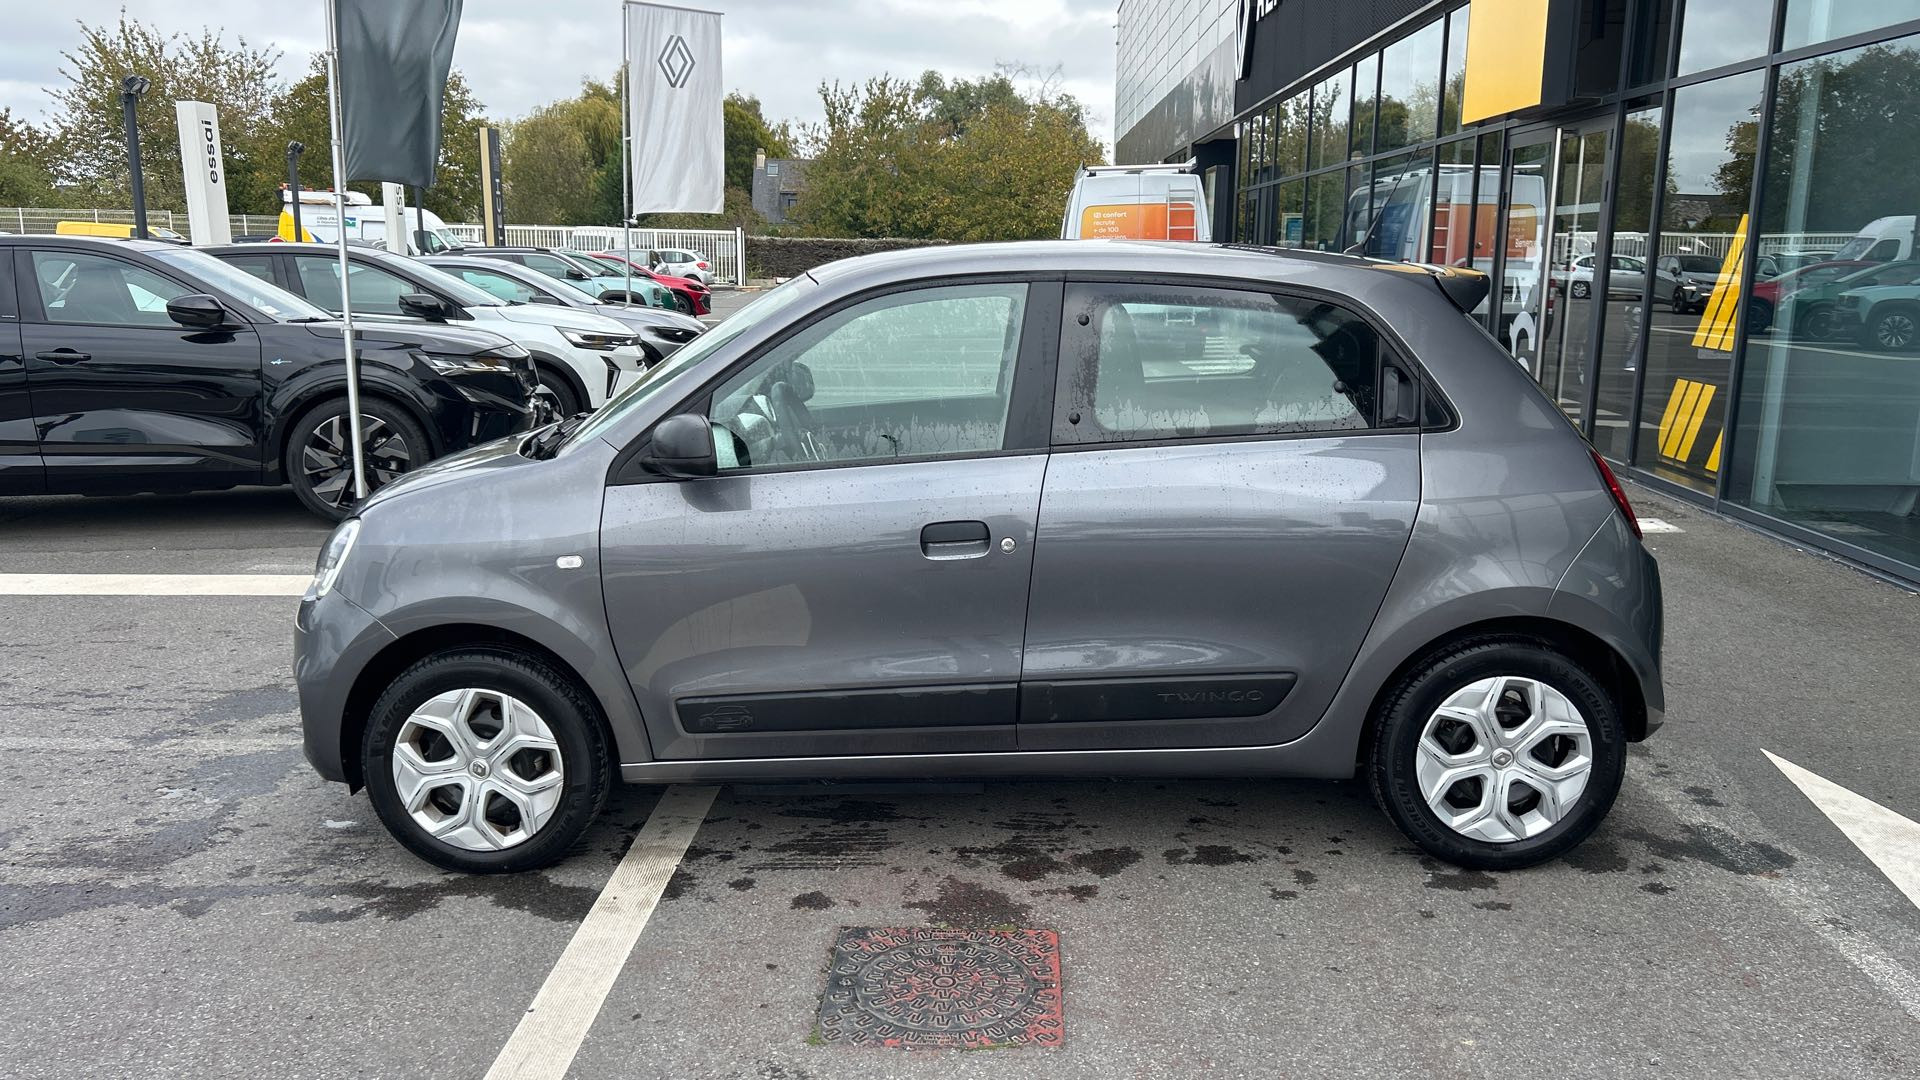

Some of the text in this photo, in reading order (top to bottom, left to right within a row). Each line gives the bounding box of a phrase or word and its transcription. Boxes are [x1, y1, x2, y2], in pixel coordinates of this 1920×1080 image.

[201, 119, 219, 184] essai
[1102, 211, 1128, 219] confort
[1157, 689, 1265, 703] TWINGO
